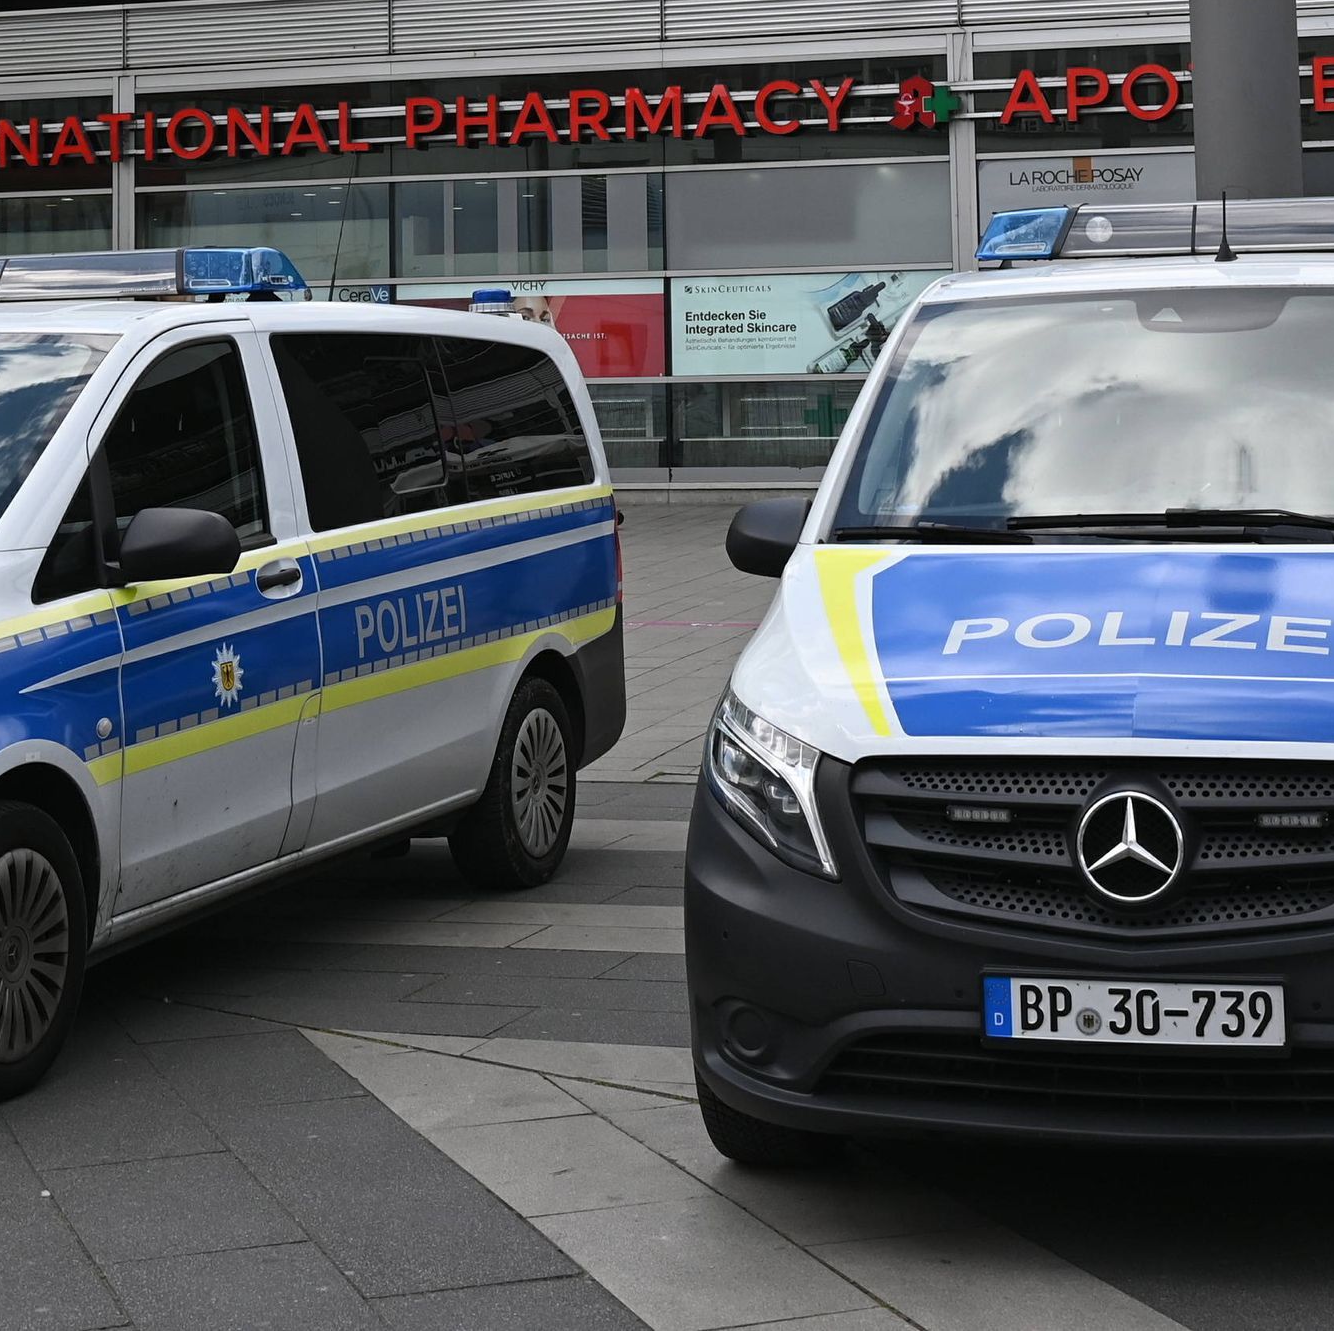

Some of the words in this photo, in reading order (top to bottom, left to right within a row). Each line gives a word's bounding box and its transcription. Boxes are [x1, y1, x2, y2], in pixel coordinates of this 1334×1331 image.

[405, 76, 855, 149] PHARMACY
[1009, 171, 1030, 185] LA
[1032, 169, 1088, 184] ROCHE
[1091, 167, 1143, 183] POSAY
[511, 281, 546, 291] VICHY
[339, 287, 389, 302] CeraVe
[685, 311, 746, 321] Entdecken
[748, 310, 767, 320] Sie
[685, 323, 744, 335] Integrated
[747, 322, 797, 333] Skincare
[354, 585, 468, 658] POLIZEI
[993, 1012, 1004, 1026] D
[1019, 984, 1072, 1033] BP
[1107, 987, 1273, 1038] 30-739
